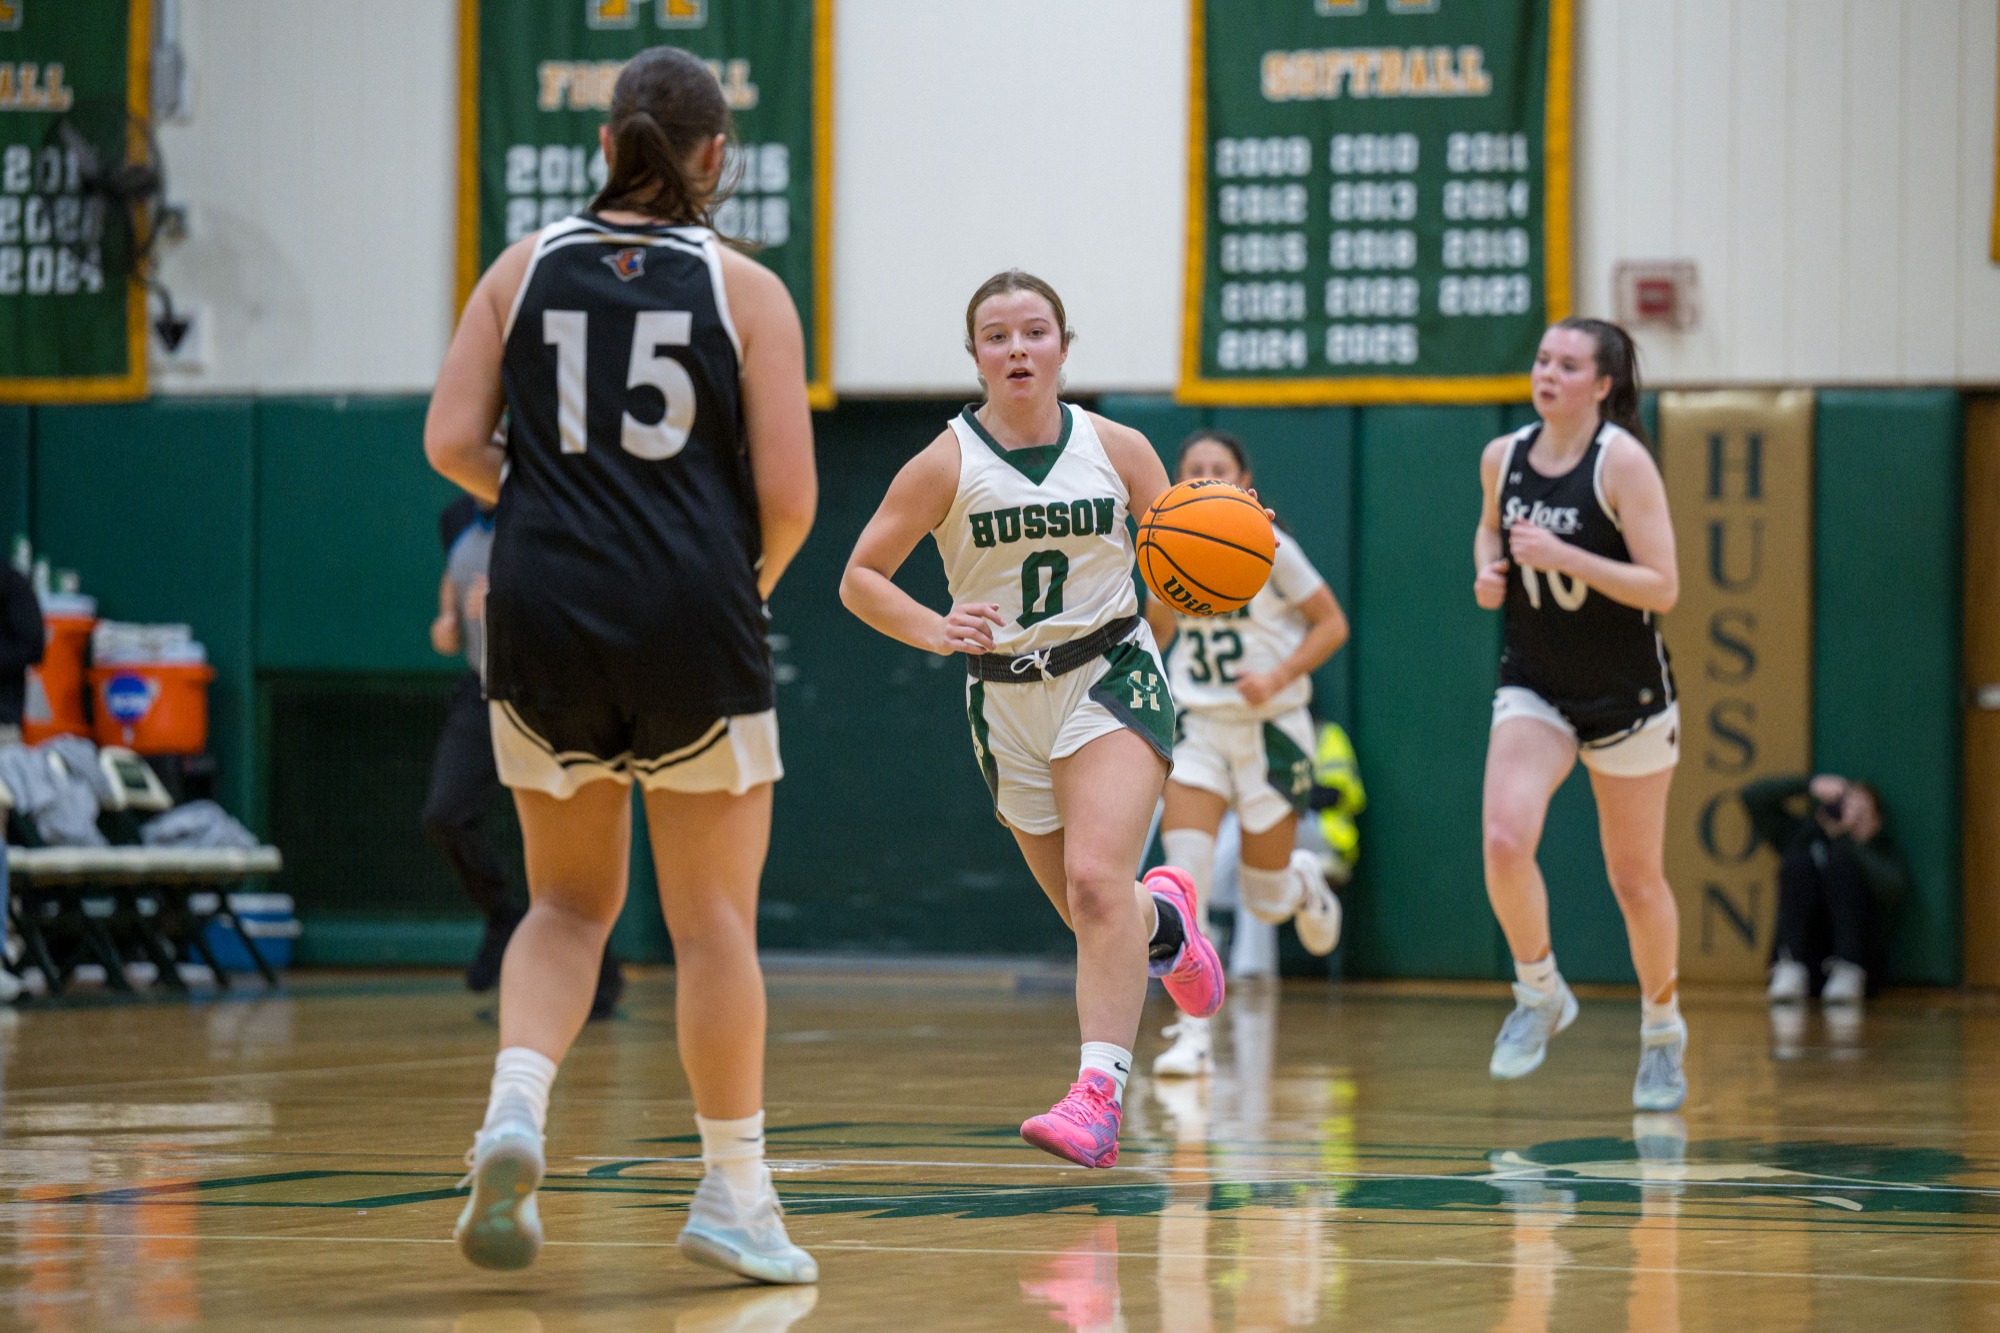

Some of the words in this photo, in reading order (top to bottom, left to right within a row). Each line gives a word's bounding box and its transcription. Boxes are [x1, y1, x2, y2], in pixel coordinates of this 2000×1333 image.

[1261, 46, 1493, 101] SOFTBALL
[1447, 132, 1528, 173] 2011
[1219, 184, 1308, 225] 2012
[1330, 181, 1417, 221] 2013
[1443, 180, 1529, 219] 2014
[1221, 282, 1307, 322] 2021
[1438, 275, 1530, 316] 2023
[1217, 329, 1307, 370] 2024
[543, 310, 697, 461] 15
[969, 497, 1115, 549] HUSSON
[1015, 549, 1069, 630] 0
[1187, 629, 1243, 684] 32
[1699, 429, 1765, 955] HUSSON
